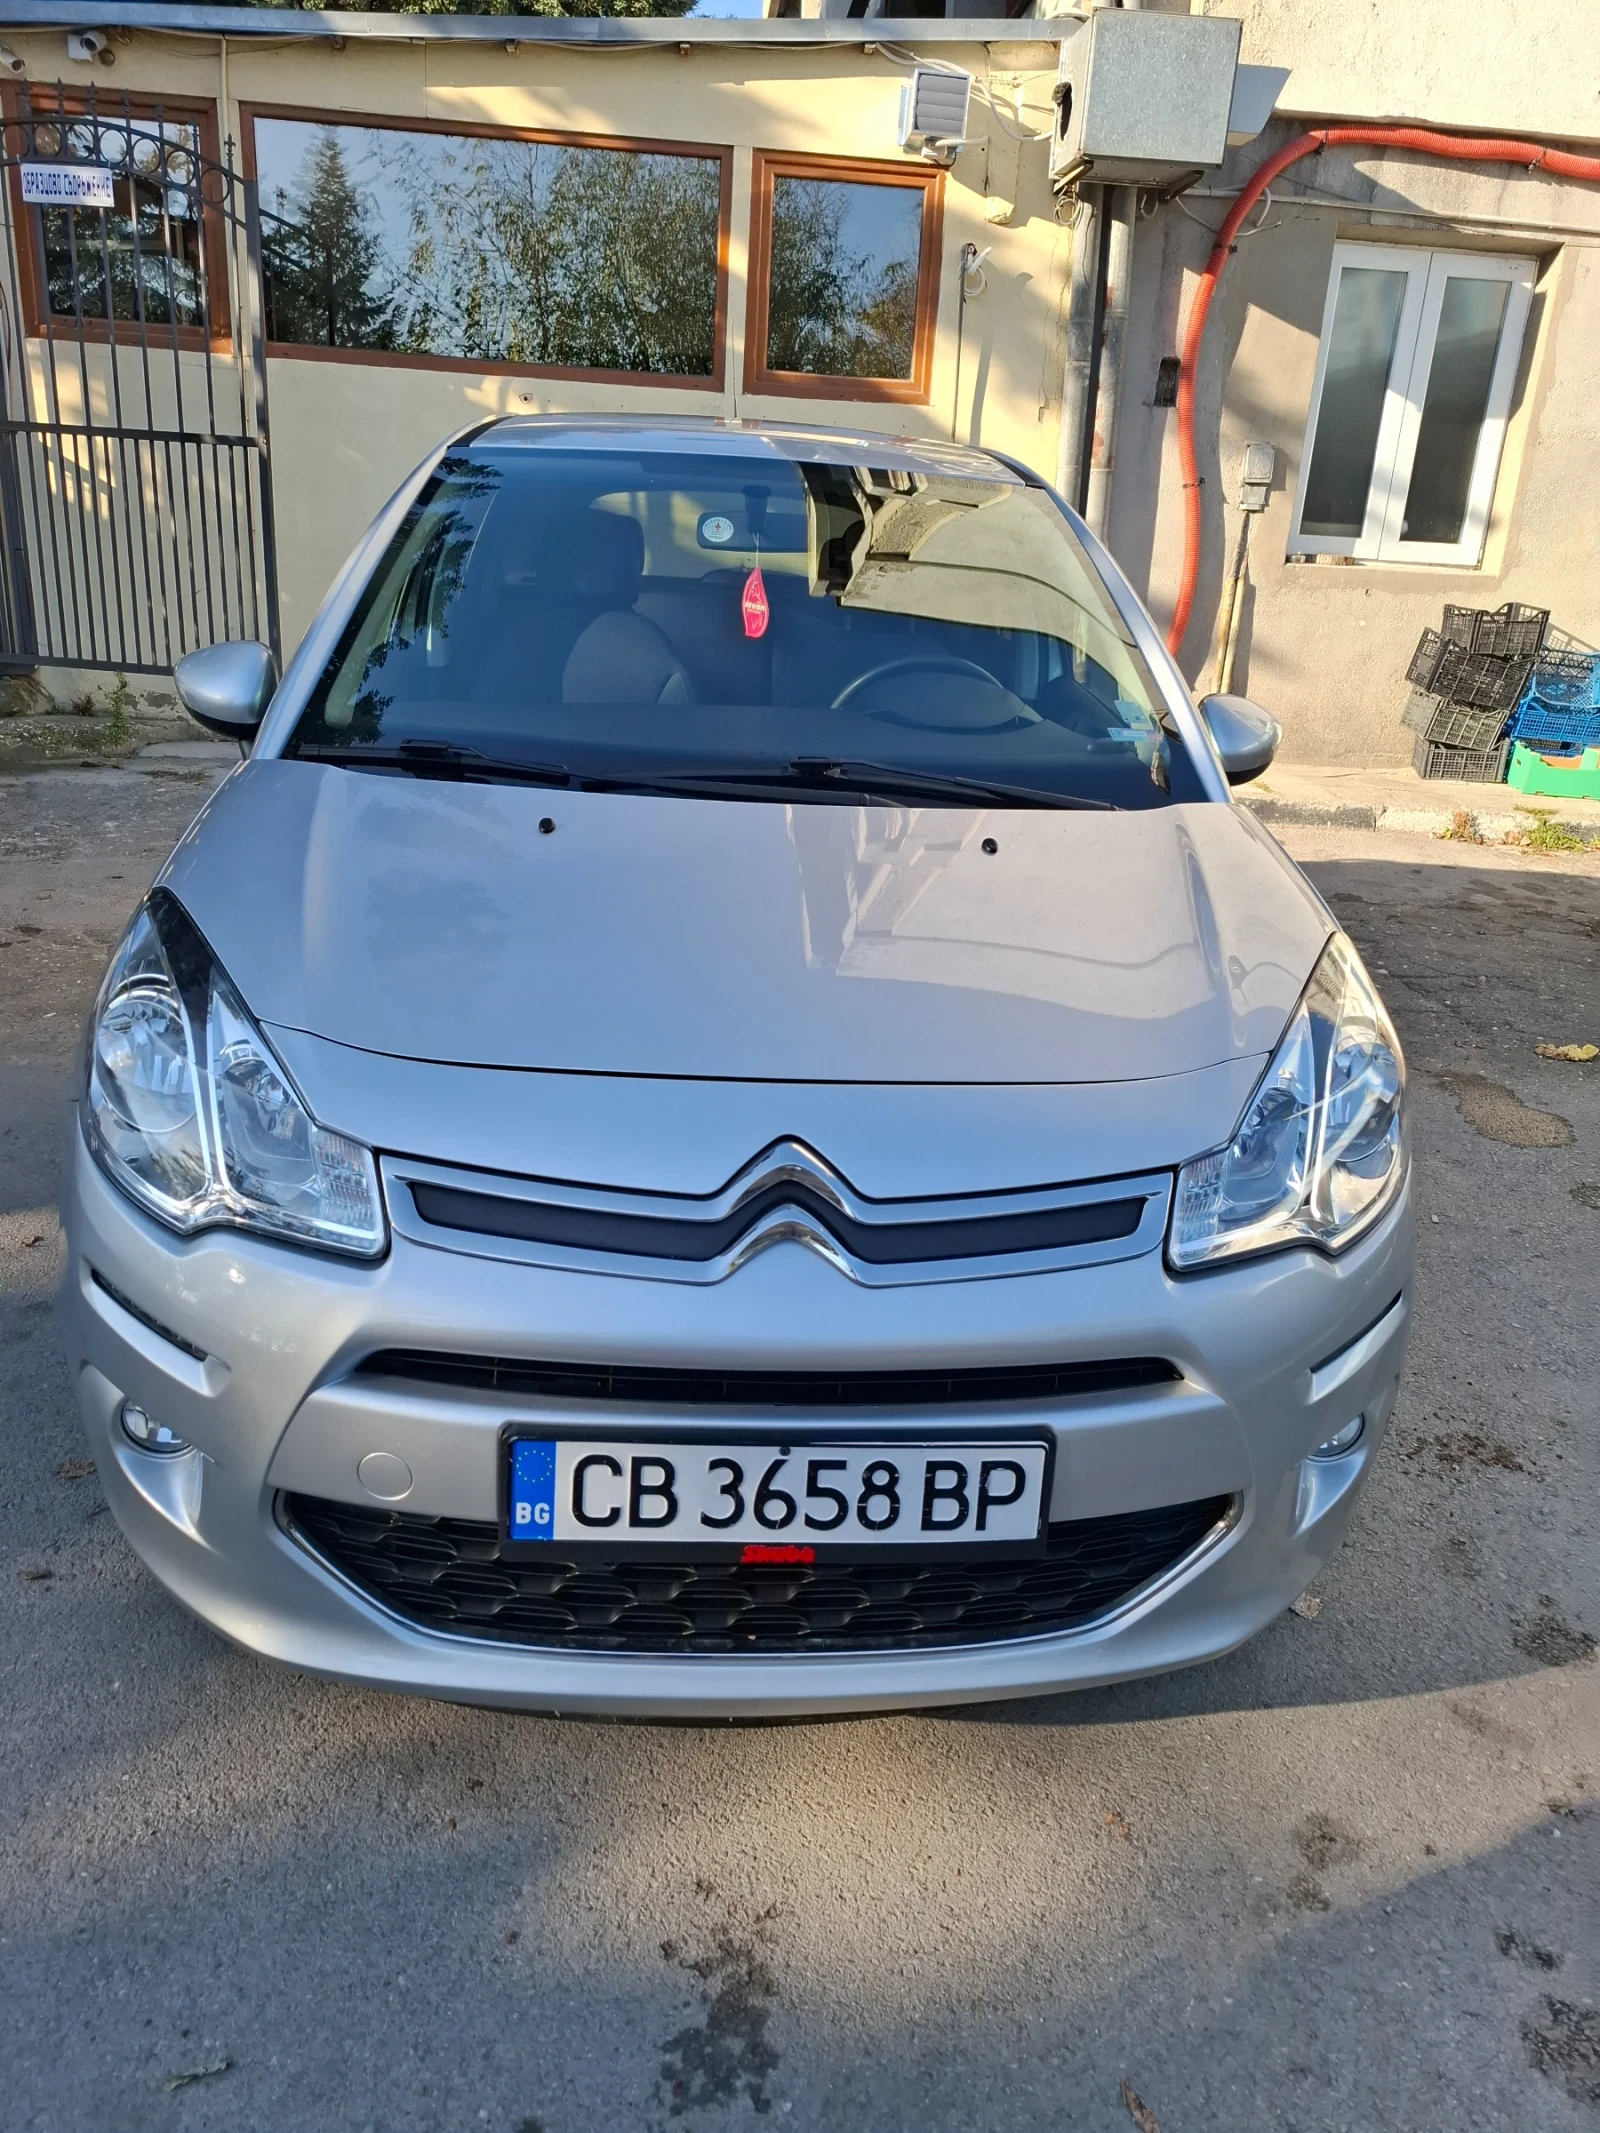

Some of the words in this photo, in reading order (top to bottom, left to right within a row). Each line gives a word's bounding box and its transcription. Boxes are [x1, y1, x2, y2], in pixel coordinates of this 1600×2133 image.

[23, 172, 61, 195] ОБРАЗЦОВО
[572, 1453, 678, 1527] CB
[699, 1457, 900, 1530] 3658
[920, 1460, 1026, 1530] BP
[515, 1502, 551, 1525] BG
